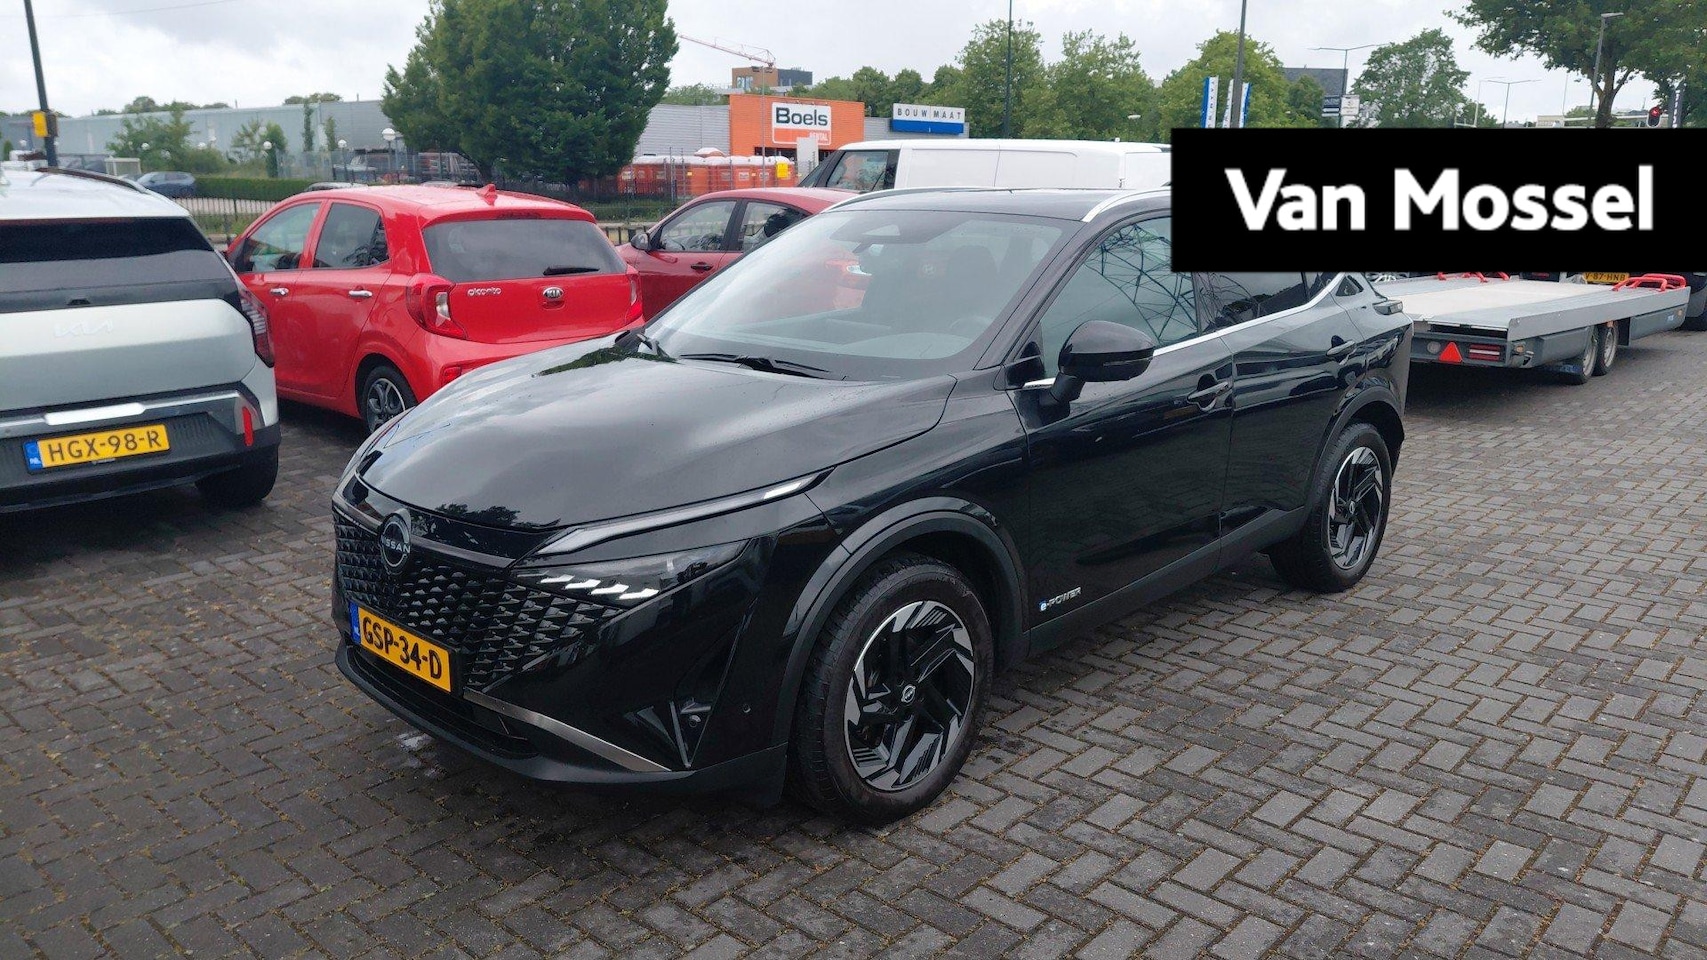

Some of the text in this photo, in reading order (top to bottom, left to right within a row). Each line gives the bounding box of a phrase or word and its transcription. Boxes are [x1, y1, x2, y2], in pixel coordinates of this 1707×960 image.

[776, 107, 828, 126] Boels
[48, 430, 162, 462] HGX-98-R
[362, 616, 443, 680] GSP-34-D
